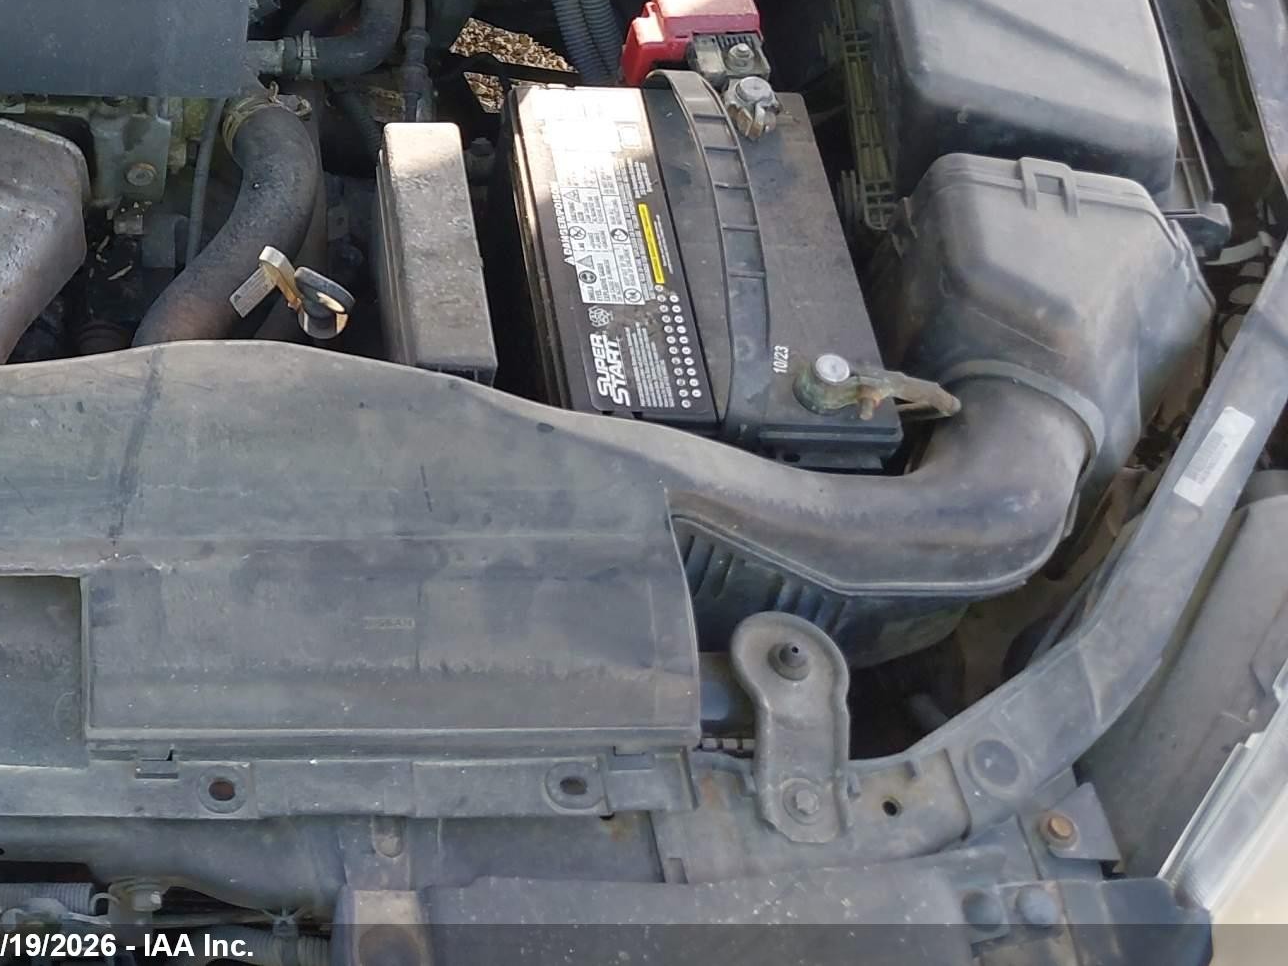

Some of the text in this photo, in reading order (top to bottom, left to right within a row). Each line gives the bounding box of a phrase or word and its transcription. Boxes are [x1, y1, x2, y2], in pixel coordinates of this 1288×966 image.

[590, 333, 614, 396] SUPER
[602, 333, 631, 406] START
[773, 345, 789, 373] 10/23
